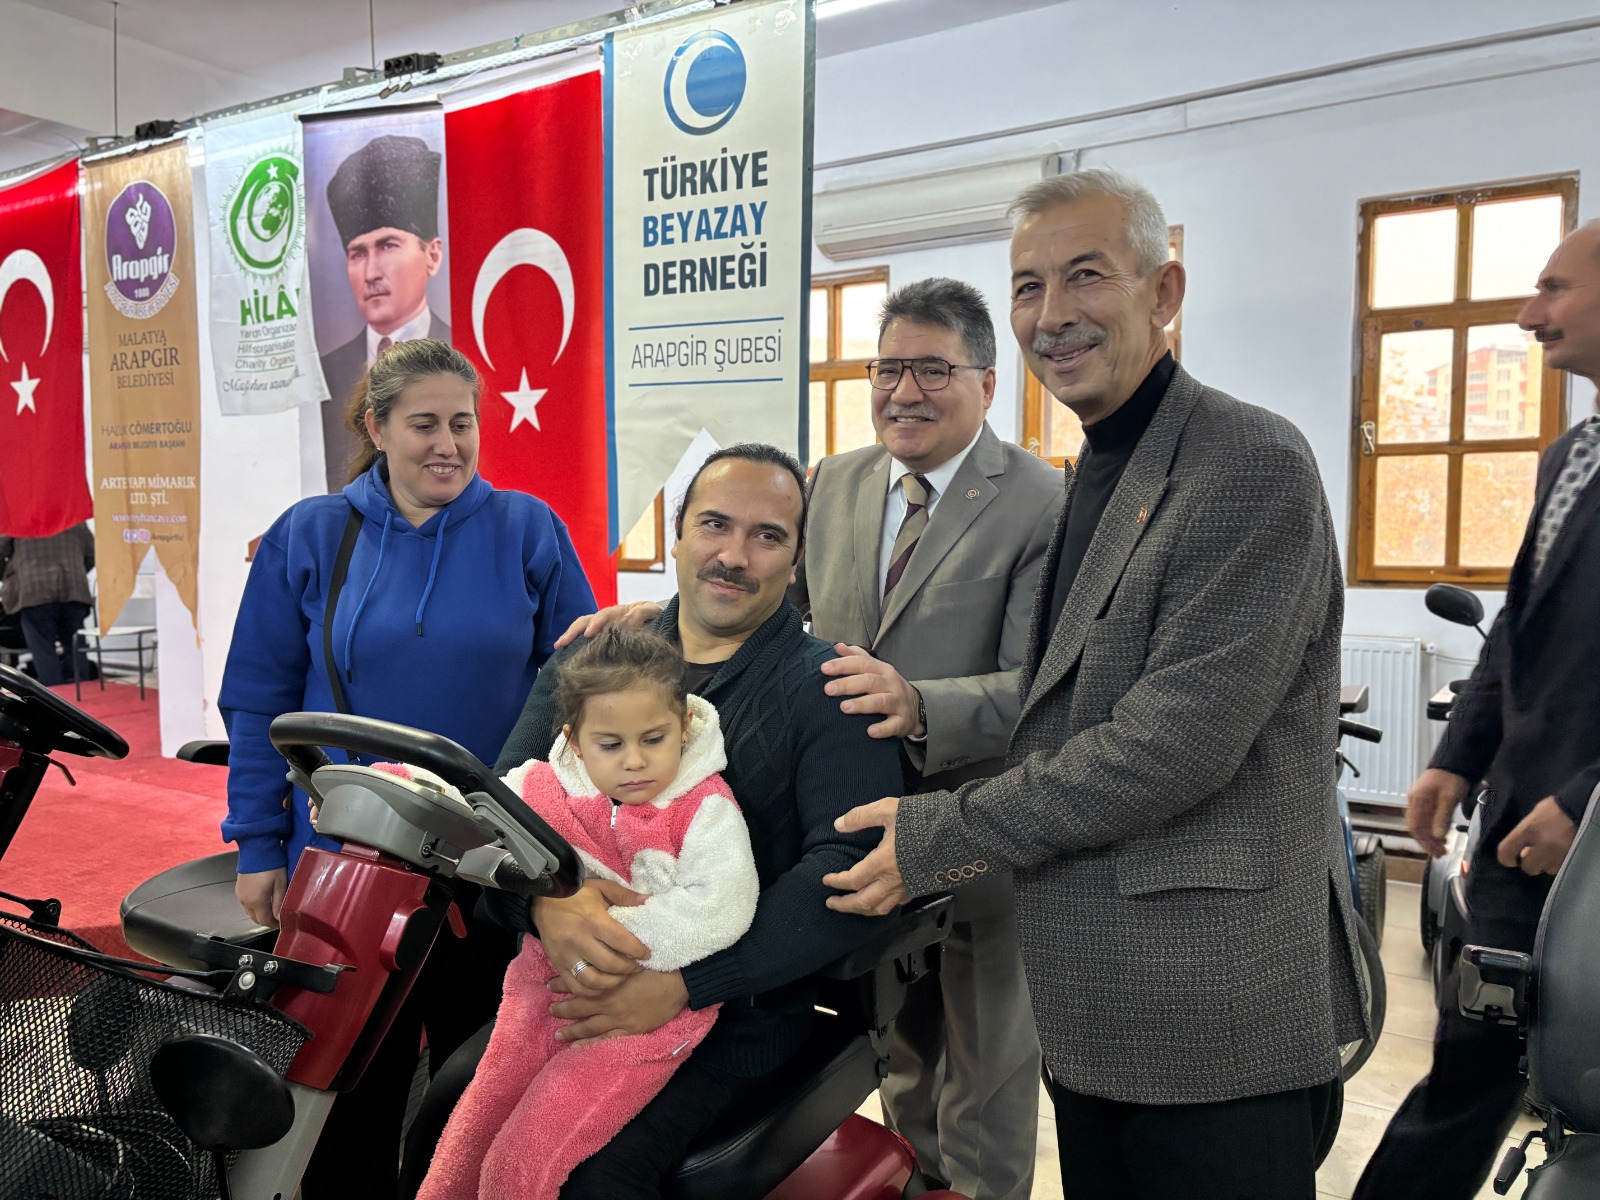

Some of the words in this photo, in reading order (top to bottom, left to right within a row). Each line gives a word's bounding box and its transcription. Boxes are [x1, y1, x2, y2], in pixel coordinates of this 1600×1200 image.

[643, 147, 768, 202] TÜRKİYE
[643, 201, 768, 248] BEYAZAY
[112, 246, 170, 283] Arapgir
[643, 241, 767, 297] DERNEĞİ
[118, 330, 167, 346] MALATYA
[631, 334, 707, 369] ARAPGİR
[714, 328, 781, 372] ŞUBESİ
[110, 343, 181, 371] ARAPGİR
[117, 368, 174, 389] BELEDİYESİ
[129, 418, 192, 435] CÖMERTOĞLU
[100, 477, 127, 489] ARTE
[148, 473, 196, 489] MİMARLIK
